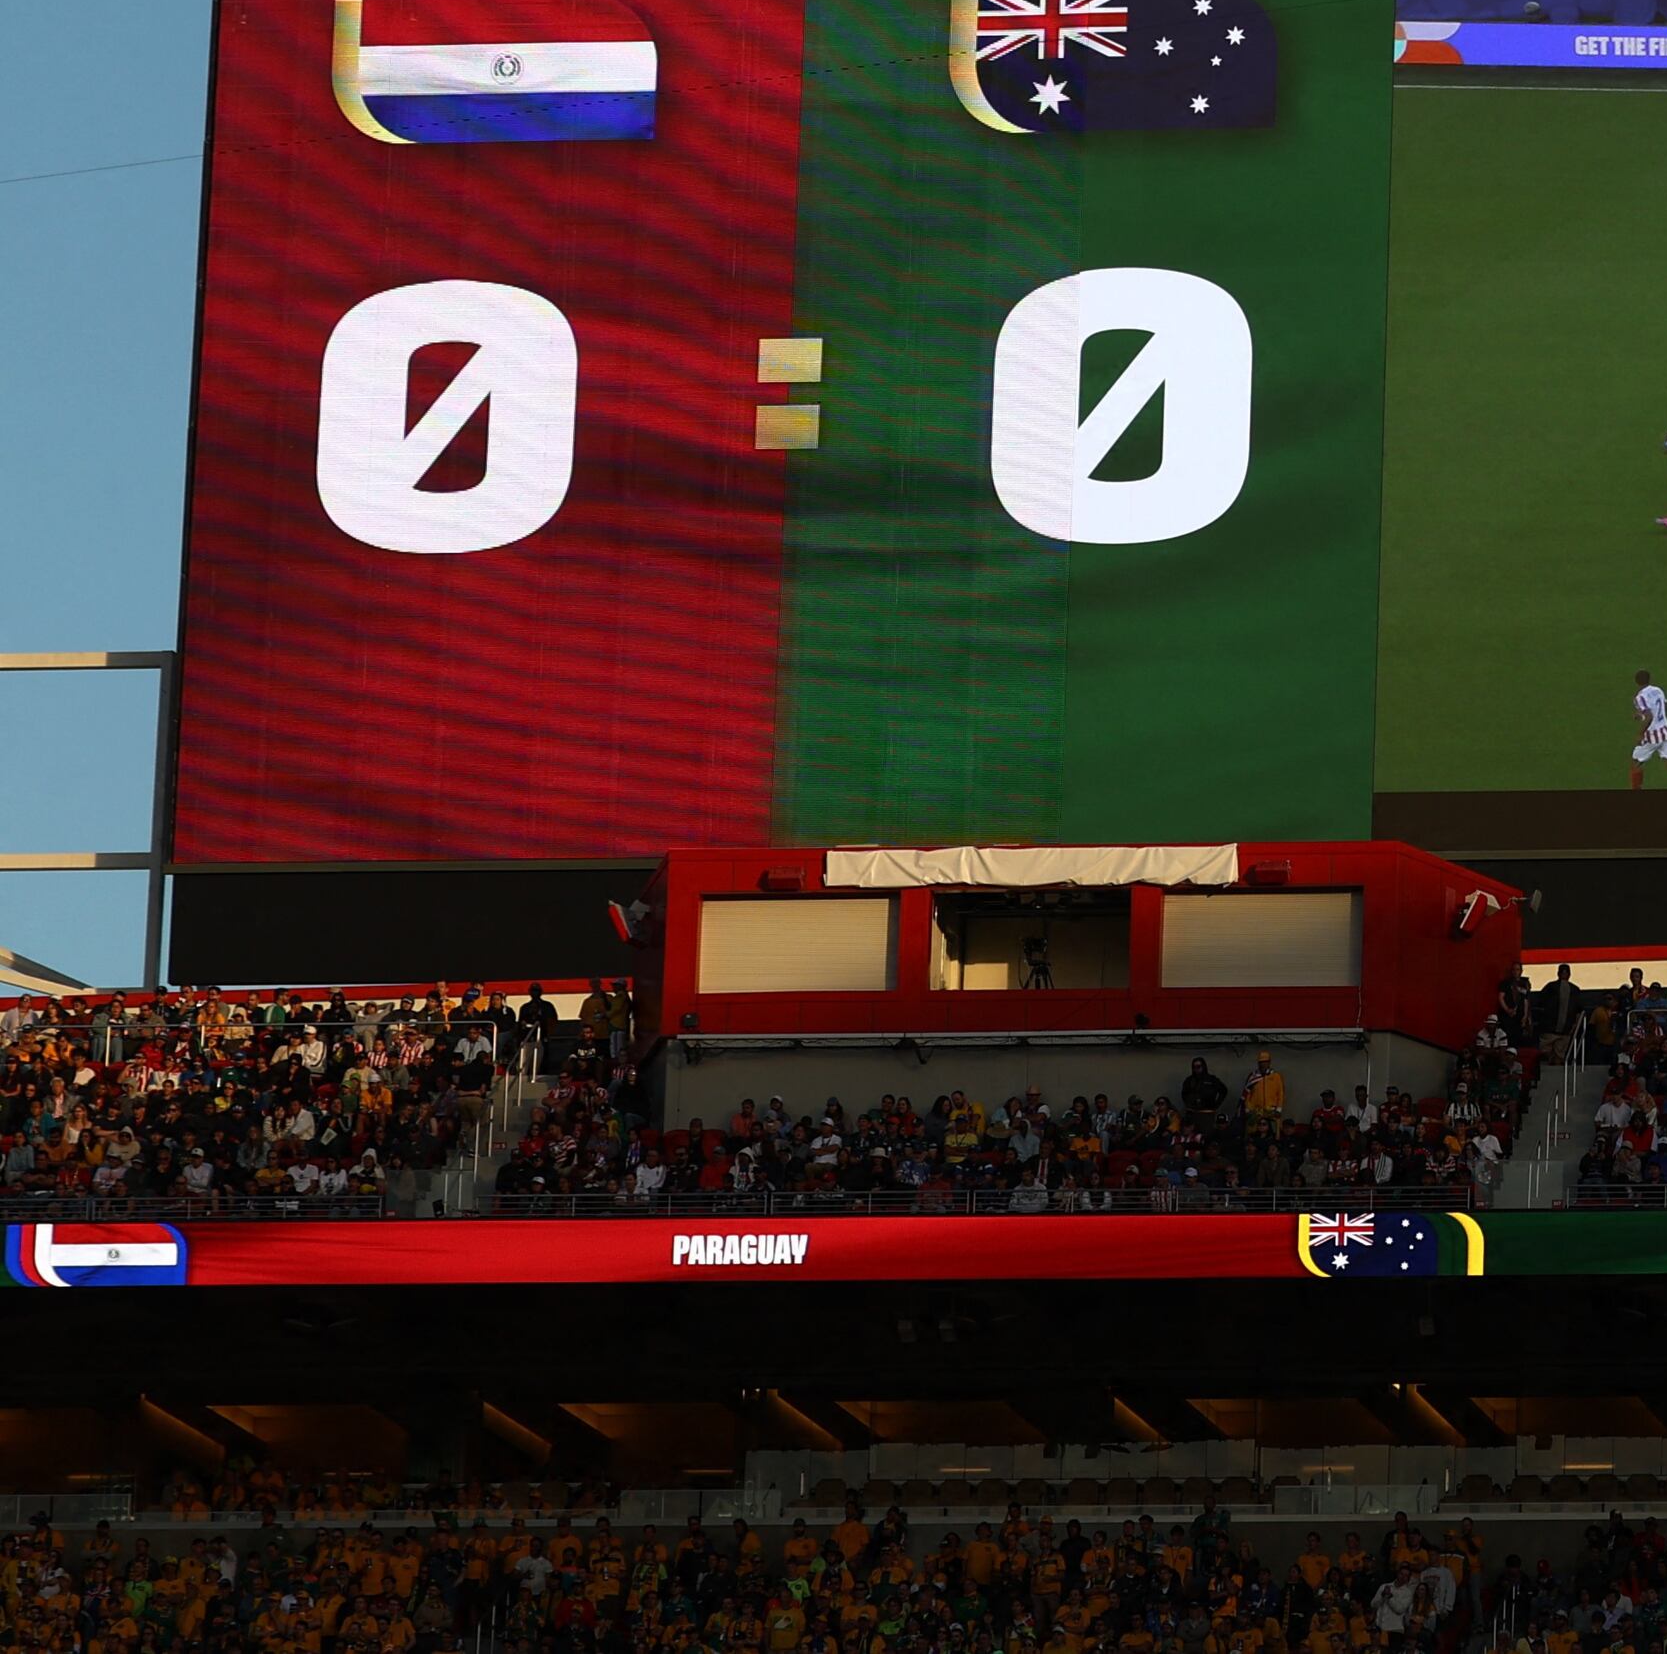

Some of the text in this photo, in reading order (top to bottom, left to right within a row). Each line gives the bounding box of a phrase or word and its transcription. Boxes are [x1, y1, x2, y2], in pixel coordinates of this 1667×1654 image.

[1575, 36, 1610, 55] GET
[1612, 37, 1646, 56] THE
[316, 279, 578, 554] 0
[990, 267, 1253, 545] 0
[672, 1234, 809, 1265] PARAGUAY
